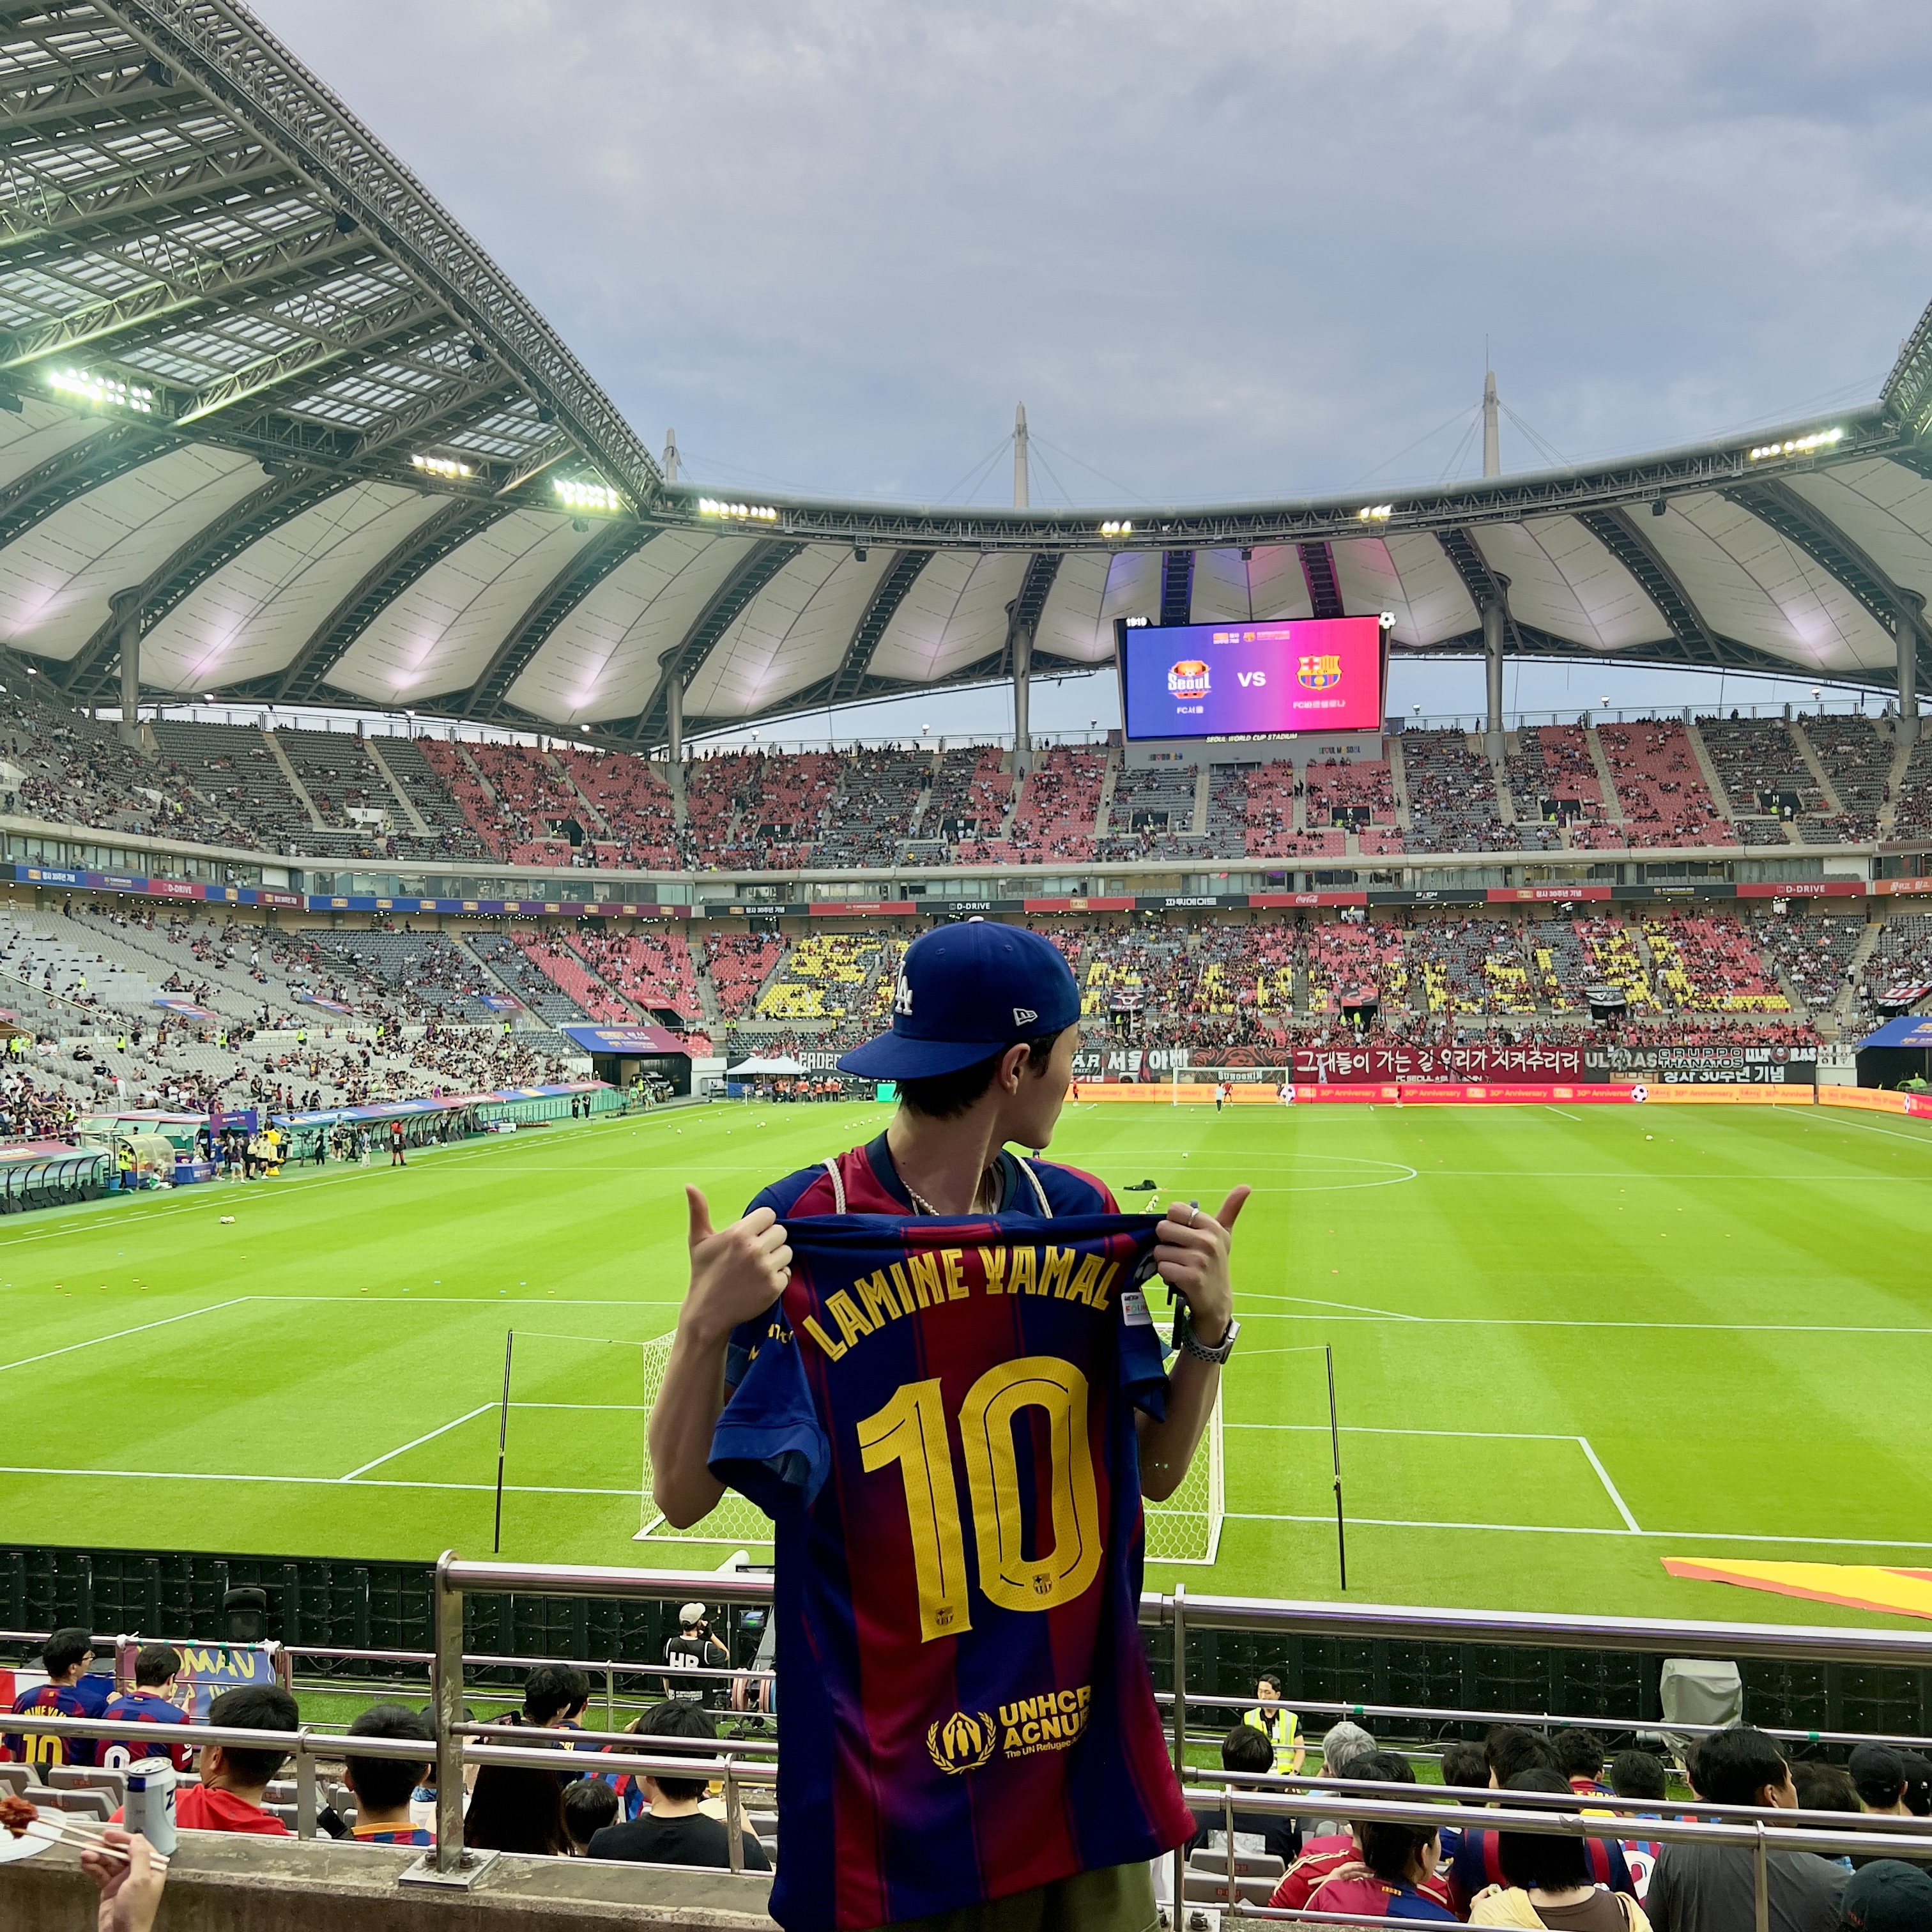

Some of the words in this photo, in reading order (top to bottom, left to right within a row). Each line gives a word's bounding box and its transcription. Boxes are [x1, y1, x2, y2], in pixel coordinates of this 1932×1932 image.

[1237, 671, 1266, 687] VS
[168, 884, 192, 894] D-DRIVE
[1786, 885, 1825, 893] D-DRIVE
[895, 960, 913, 1015] LA
[1296, 1050, 1369, 1075] 그대들이
[1376, 1050, 1411, 1073] 가는
[1418, 1049, 1434, 1073] 길
[1438, 1048, 1487, 1072] 우리가
[1659, 1048, 1743, 1059] GRUPPO
[1658, 1058, 1744, 1069] THANATOS
[1754, 1066, 1785, 1082] 기념
[1334, 1089, 1376, 1098] Anniversary
[1419, 1089, 1461, 1098] Anniversary
[1505, 1089, 1547, 1098] Anniversary
[802, 1248, 969, 1362] LAMINE
[978, 1245, 1120, 1311] YAMAL
[857, 1356, 1103, 1643] 10
[999, 1685, 1091, 1726] UNHCR
[1005, 1751, 1021, 1759] The
[1022, 1745, 1036, 1756] UN
[1036, 1740, 1071, 1752] Refugee
